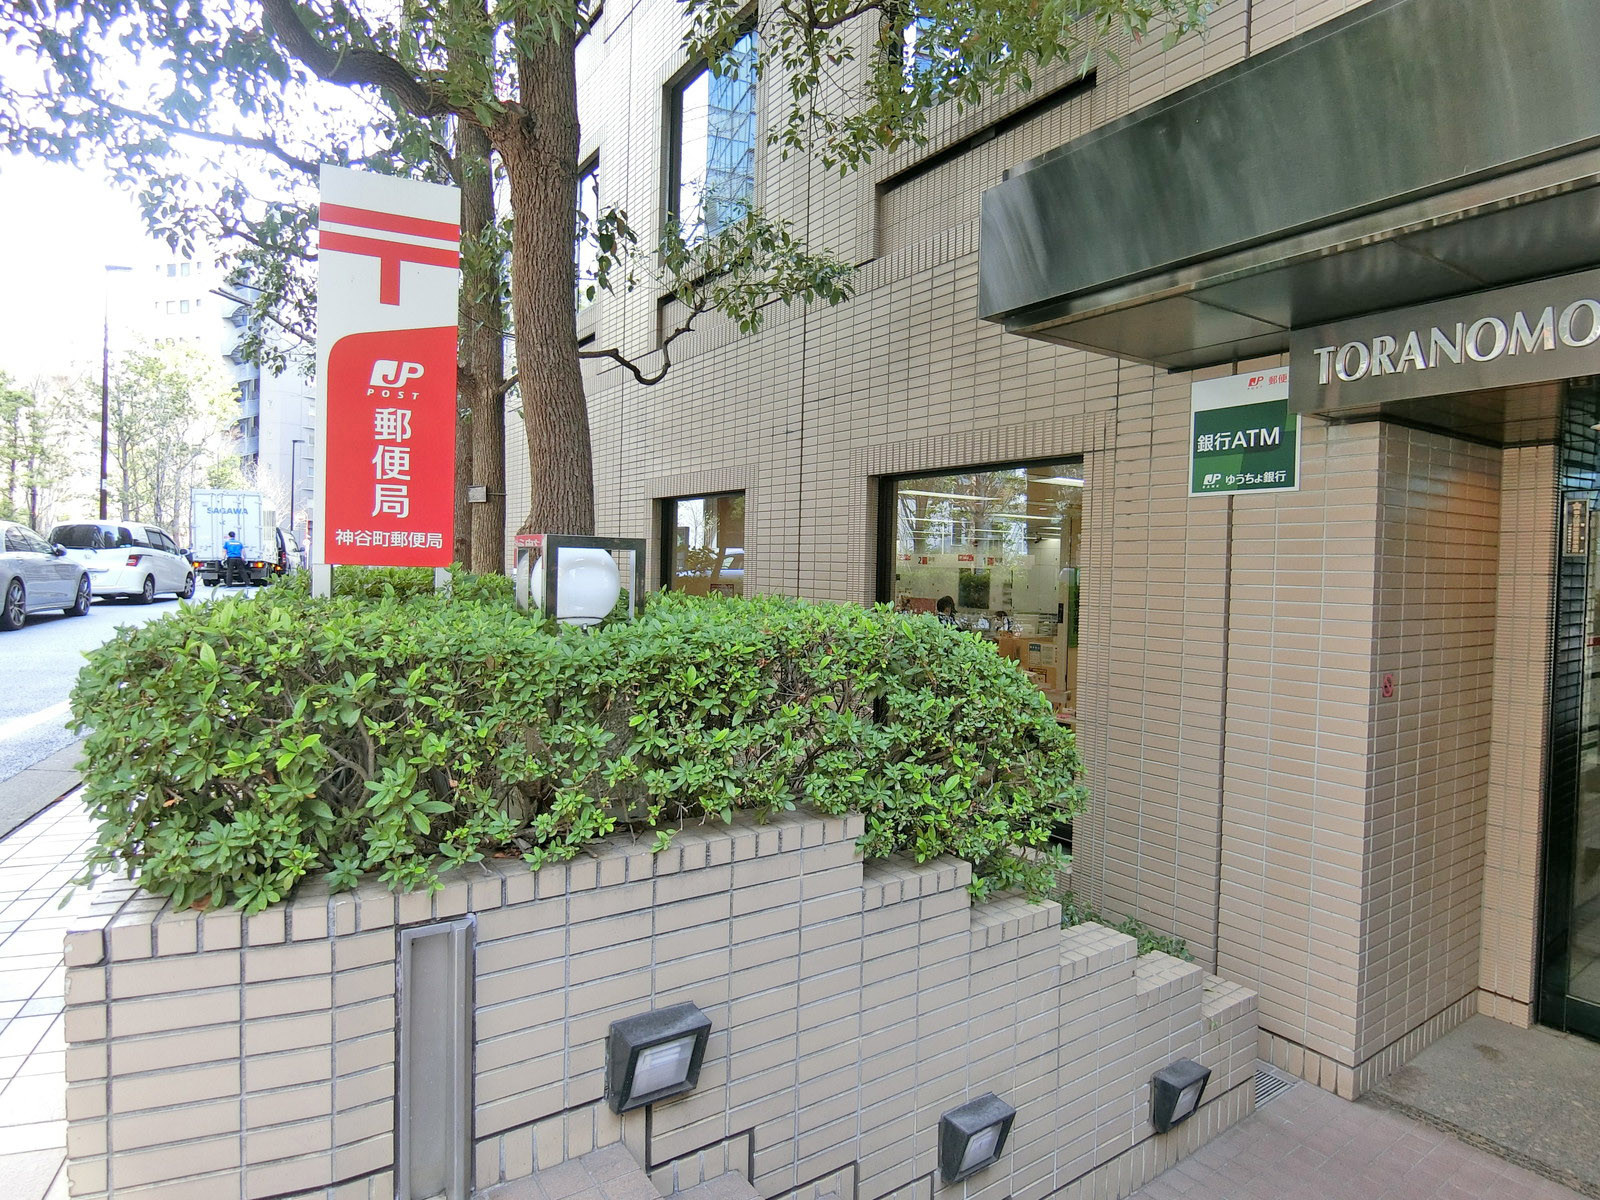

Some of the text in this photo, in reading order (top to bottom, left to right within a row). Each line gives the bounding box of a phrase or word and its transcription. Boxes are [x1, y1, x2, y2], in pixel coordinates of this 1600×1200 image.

[1313, 298, 1600, 386] TORANOMO
[366, 388, 420, 400] POST
[1196, 426, 1280, 453] 銀行ATM
[371, 407, 412, 519] 郵便局
[1225, 470, 1287, 486] ゆうちょ銀行
[206, 507, 249, 515] SAGAWA
[335, 528, 443, 549] 神谷町郵便局
